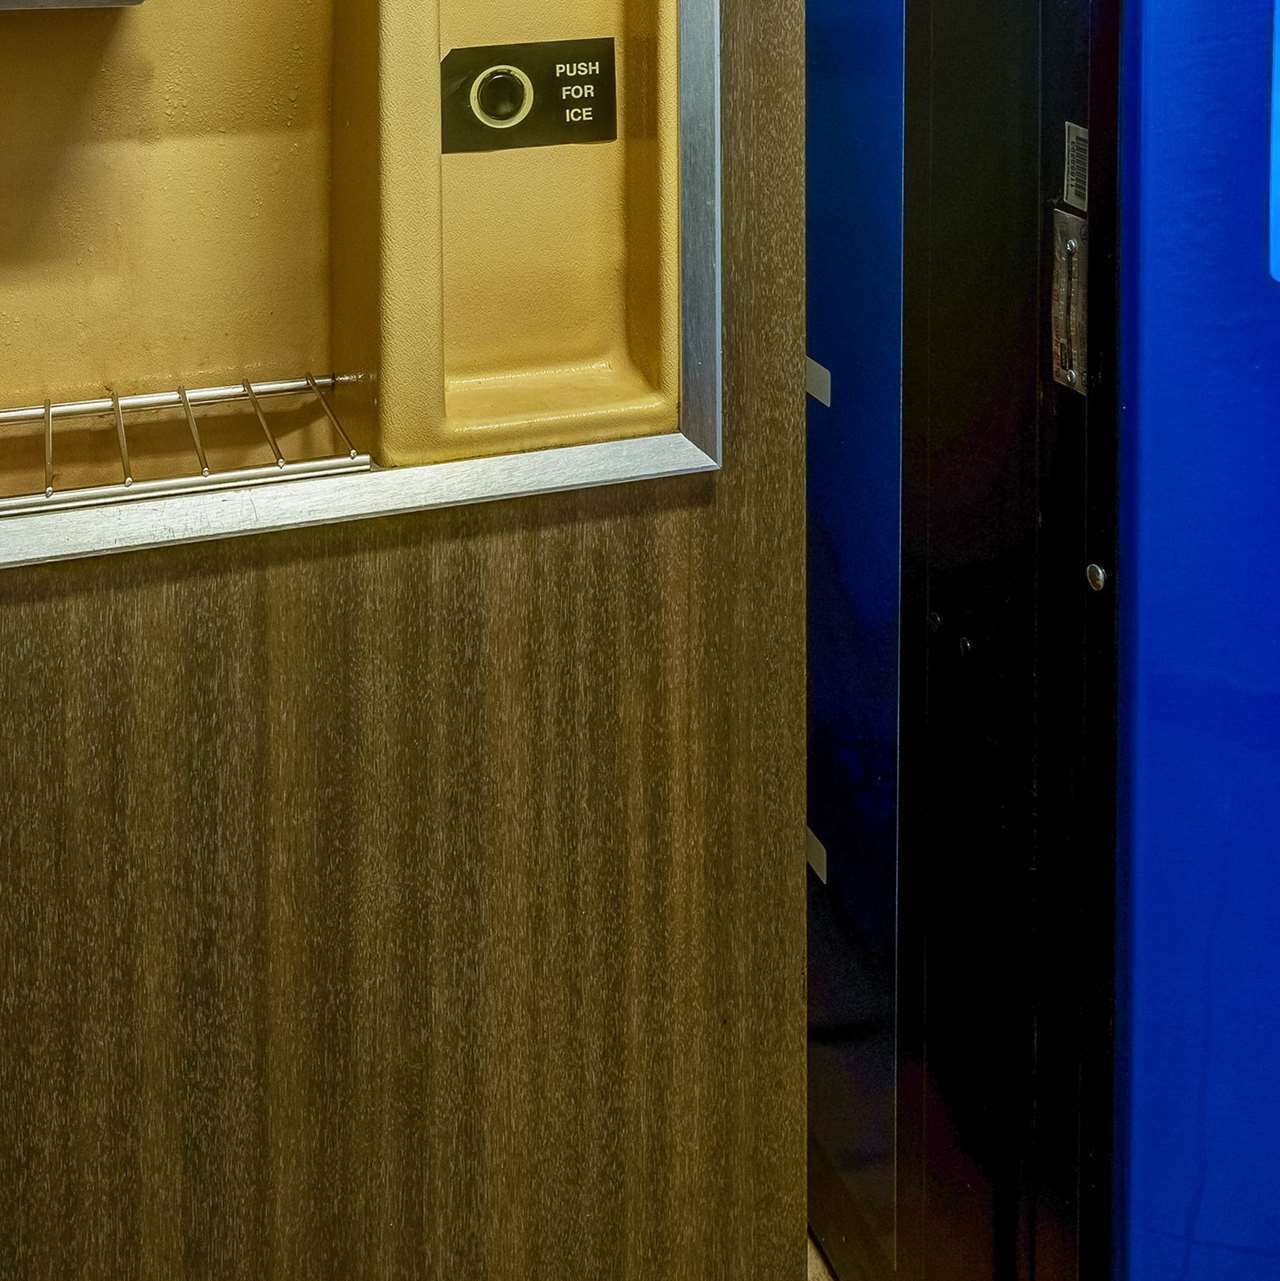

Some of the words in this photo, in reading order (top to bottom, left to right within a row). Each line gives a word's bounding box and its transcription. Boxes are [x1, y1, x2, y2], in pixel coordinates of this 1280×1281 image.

[555, 61, 600, 77] PUSH
[562, 85, 595, 100] FOR
[565, 108, 593, 122] ICE
